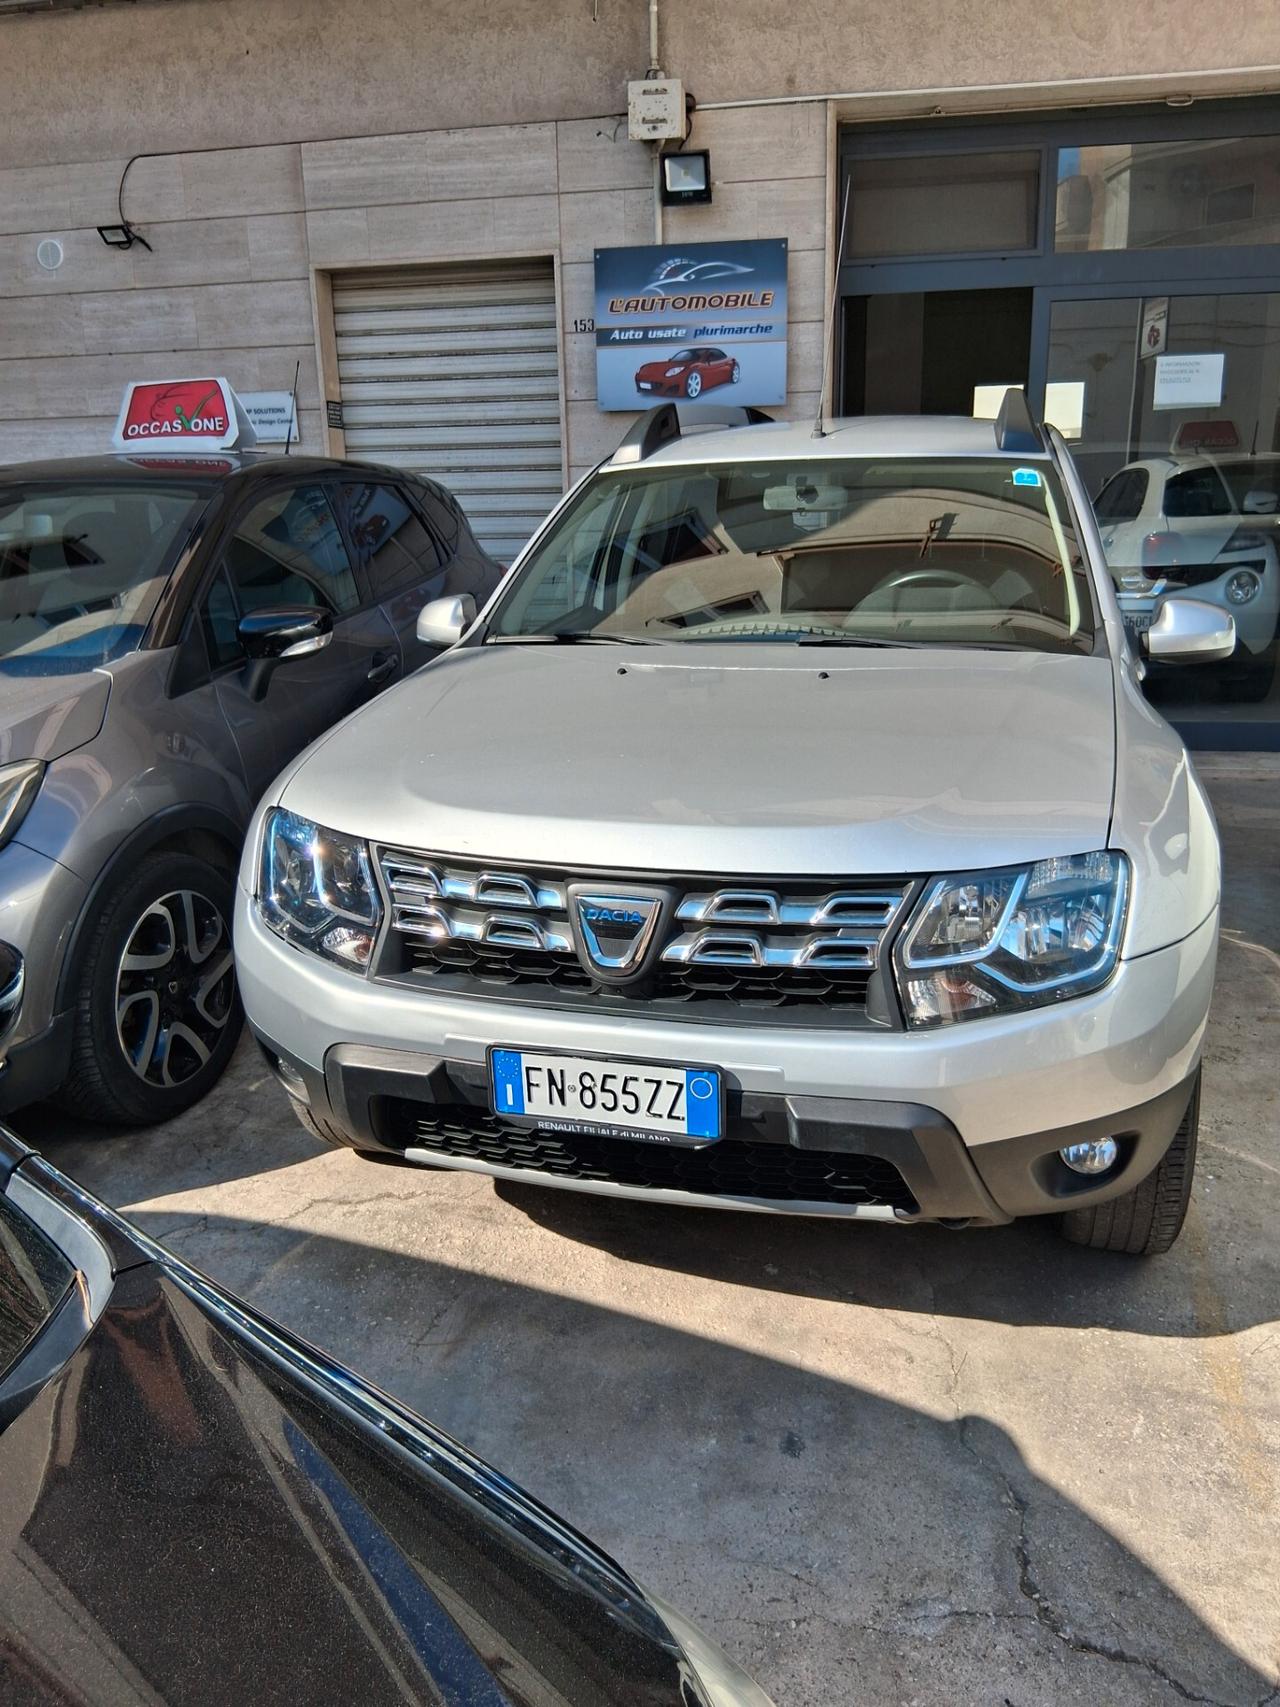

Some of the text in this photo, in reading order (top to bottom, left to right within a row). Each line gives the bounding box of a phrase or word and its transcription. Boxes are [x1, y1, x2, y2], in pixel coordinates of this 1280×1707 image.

[608, 291, 775, 315] L'AUTOMOBILE
[573, 318, 595, 333] 153
[609, 323, 773, 341] Auto usate plurimarche
[253, 407, 286, 415] SOLUTIONS
[586, 908, 643, 923] DACIA
[537, 1120, 580, 1133] RENAULT
